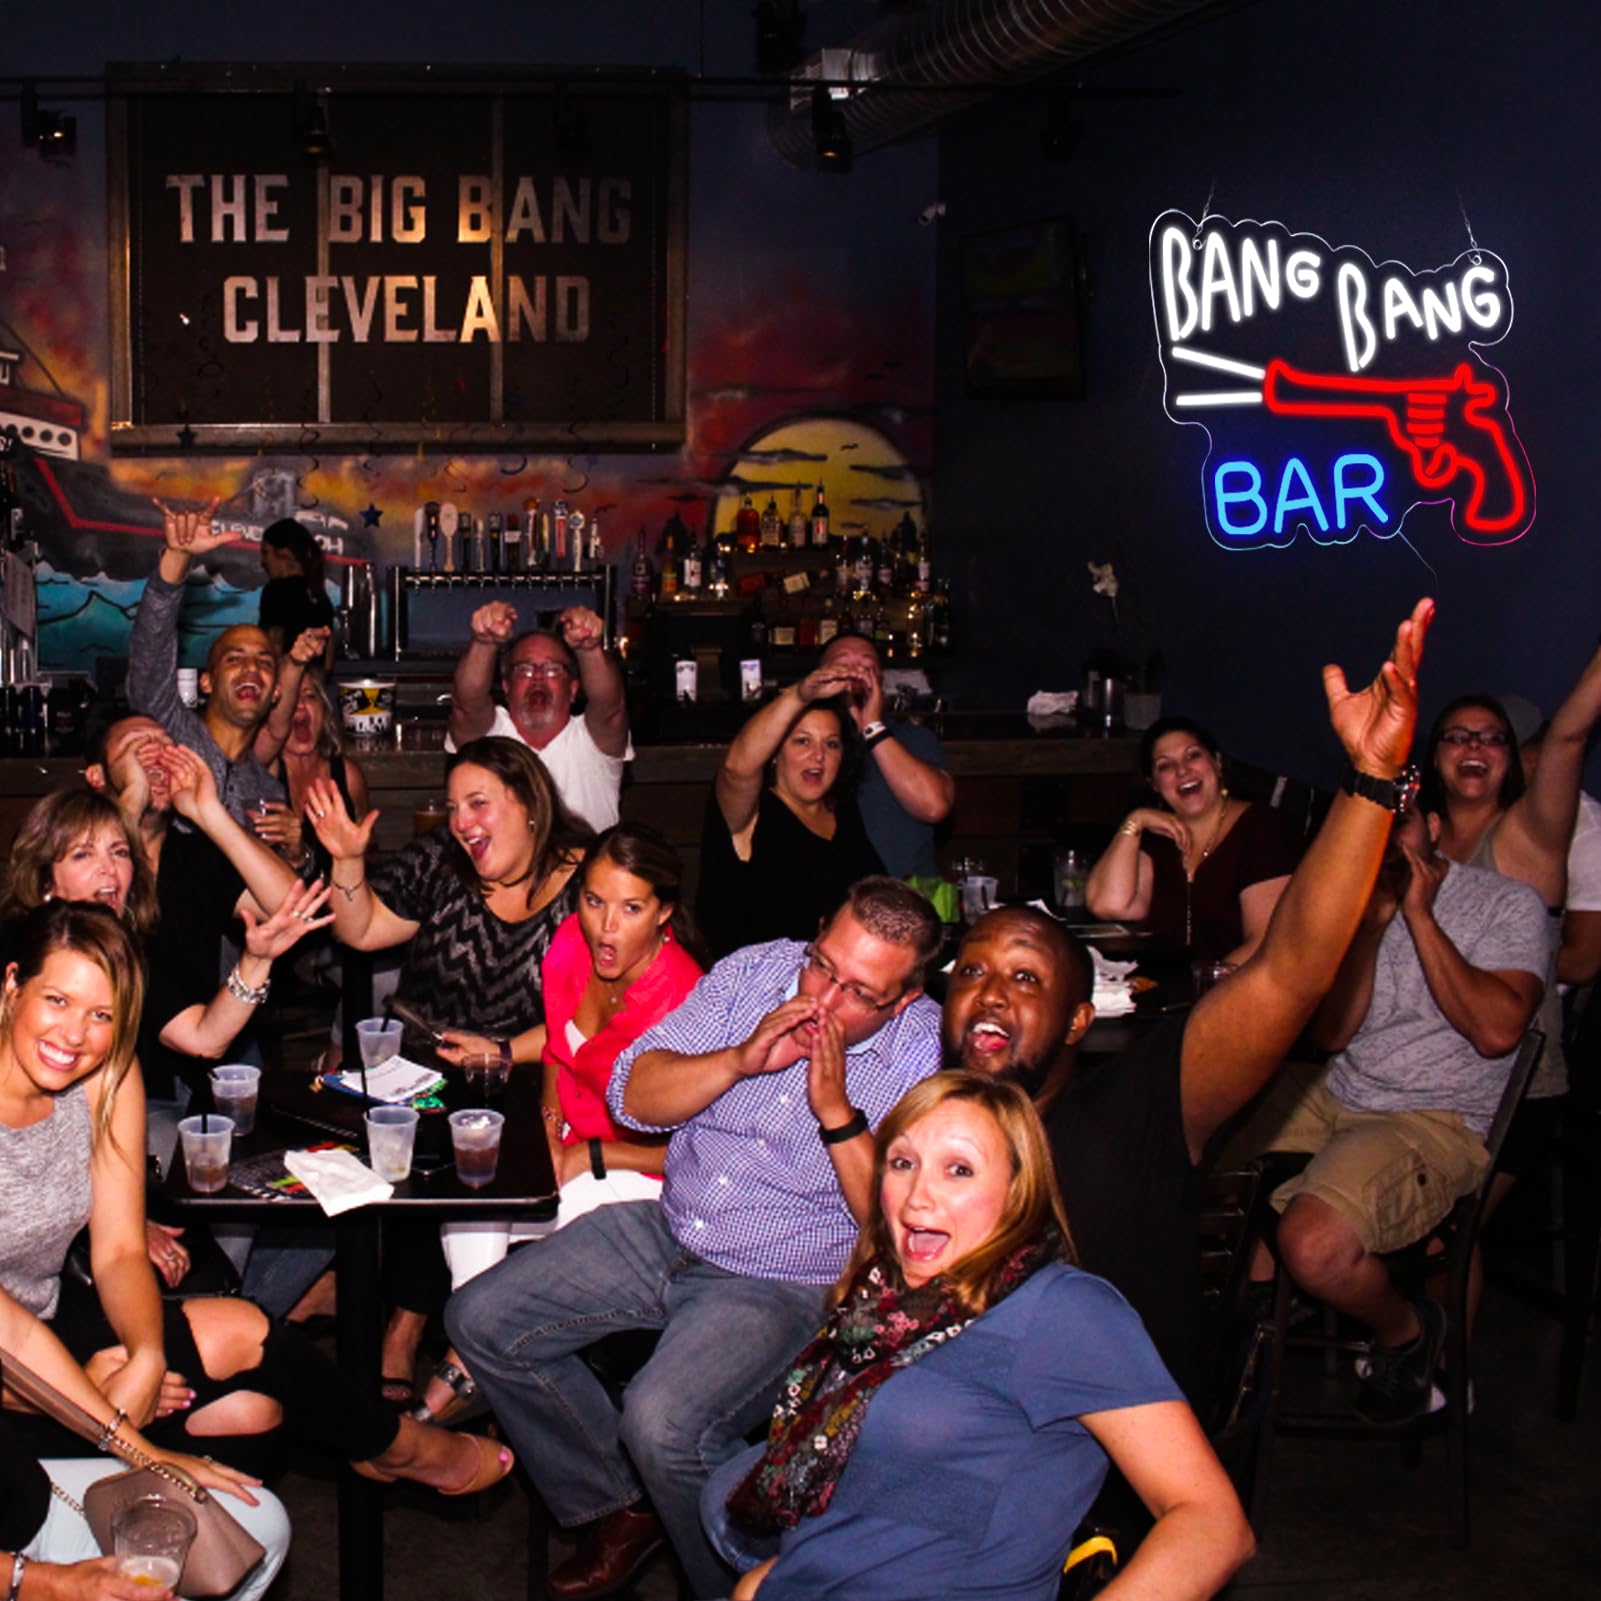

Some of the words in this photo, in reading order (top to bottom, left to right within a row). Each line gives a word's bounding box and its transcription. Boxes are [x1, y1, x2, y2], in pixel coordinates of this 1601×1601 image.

[165, 173, 290, 243] THE
[328, 173, 427, 244] BIG
[457, 174, 632, 244] BANG
[223, 275, 591, 343] CLEVELAND
[1162, 227, 1321, 341] BANG
[1337, 262, 1501, 372] BANG
[1214, 453, 1389, 535] BAR
